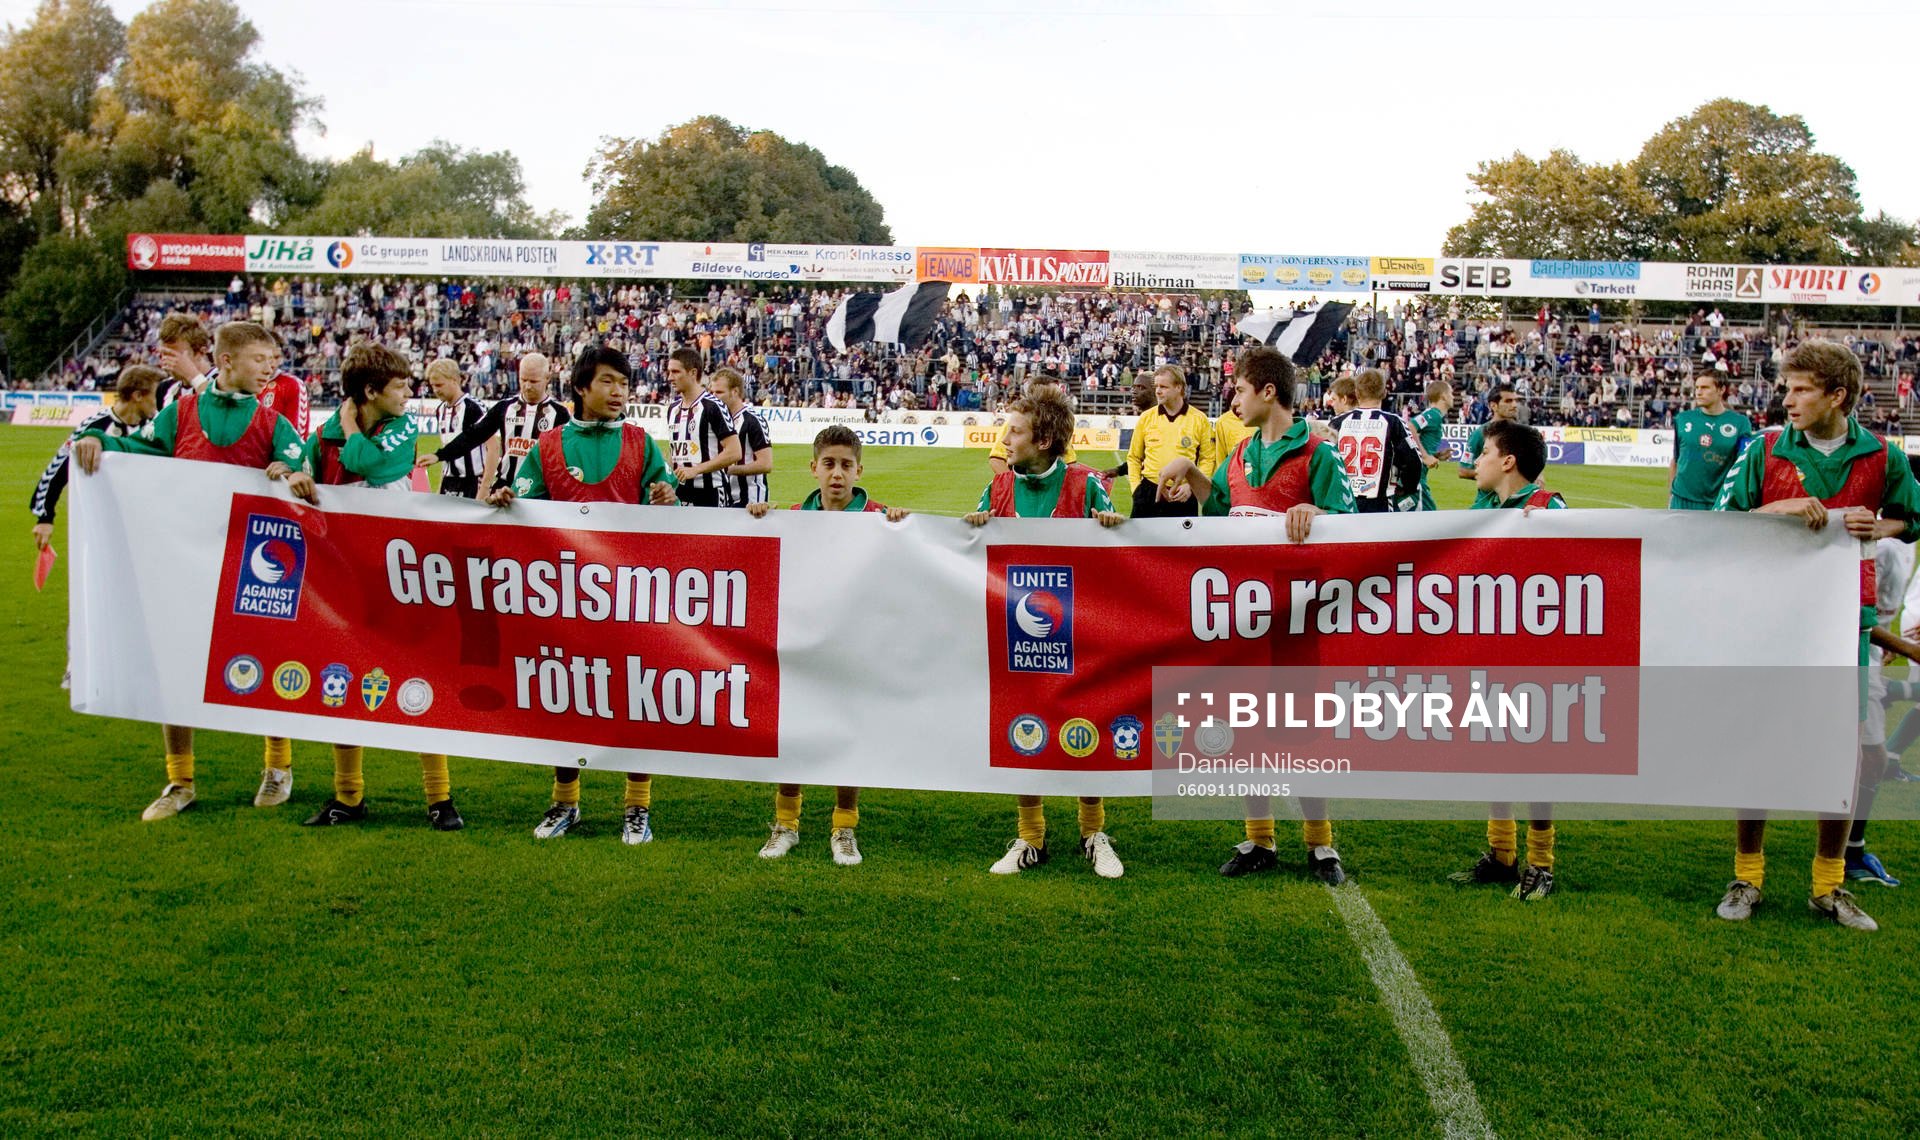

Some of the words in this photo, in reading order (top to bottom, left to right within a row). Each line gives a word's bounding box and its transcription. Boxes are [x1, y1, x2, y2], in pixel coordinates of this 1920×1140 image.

[361, 244, 377, 256] GC
[380, 247, 428, 258] gruppen
[442, 245, 513, 262] LANDSKRONA
[516, 246, 557, 263] POSTEN
[692, 262, 743, 273] Bildeve
[919, 253, 977, 278] TEAMAB
[980, 253, 1109, 283] KVÄLLSPOSTEN
[1241, 256, 1272, 264] EVENT
[1281, 256, 1339, 266] KONFERENS
[1346, 257, 1369, 266] FEST
[1532, 261, 1604, 277] Carl-Philips
[1607, 262, 1635, 277] VVS
[743, 269, 790, 279] Nordea
[1113, 271, 1195, 288] Bilhörnan
[1439, 265, 1511, 289] SEB
[1687, 266, 1734, 278] ROHM
[1768, 268, 1848, 291] SPORT
[1590, 282, 1635, 294] Tarkett
[1691, 279, 1733, 291] HAAS
[1684, 422, 1693, 433] 3
[1338, 436, 1385, 478] 26
[1630, 455, 1655, 465] Mega
[251, 519, 303, 541] UNITE
[385, 538, 456, 608] Ge
[466, 550, 748, 628] rasismen
[1012, 572, 1068, 588] UNITE
[241, 583, 296, 602] AGAINST
[239, 597, 292, 616] RACISM
[1189, 566, 1273, 642] Ge
[1288, 562, 1605, 637] rasismen
[1014, 641, 1067, 654] AGAINST
[1014, 655, 1068, 670] RACISM
[514, 645, 614, 719] rött
[626, 654, 751, 728] kort
[1333, 666, 1453, 743] rött
[1469, 669, 1606, 744] kort
